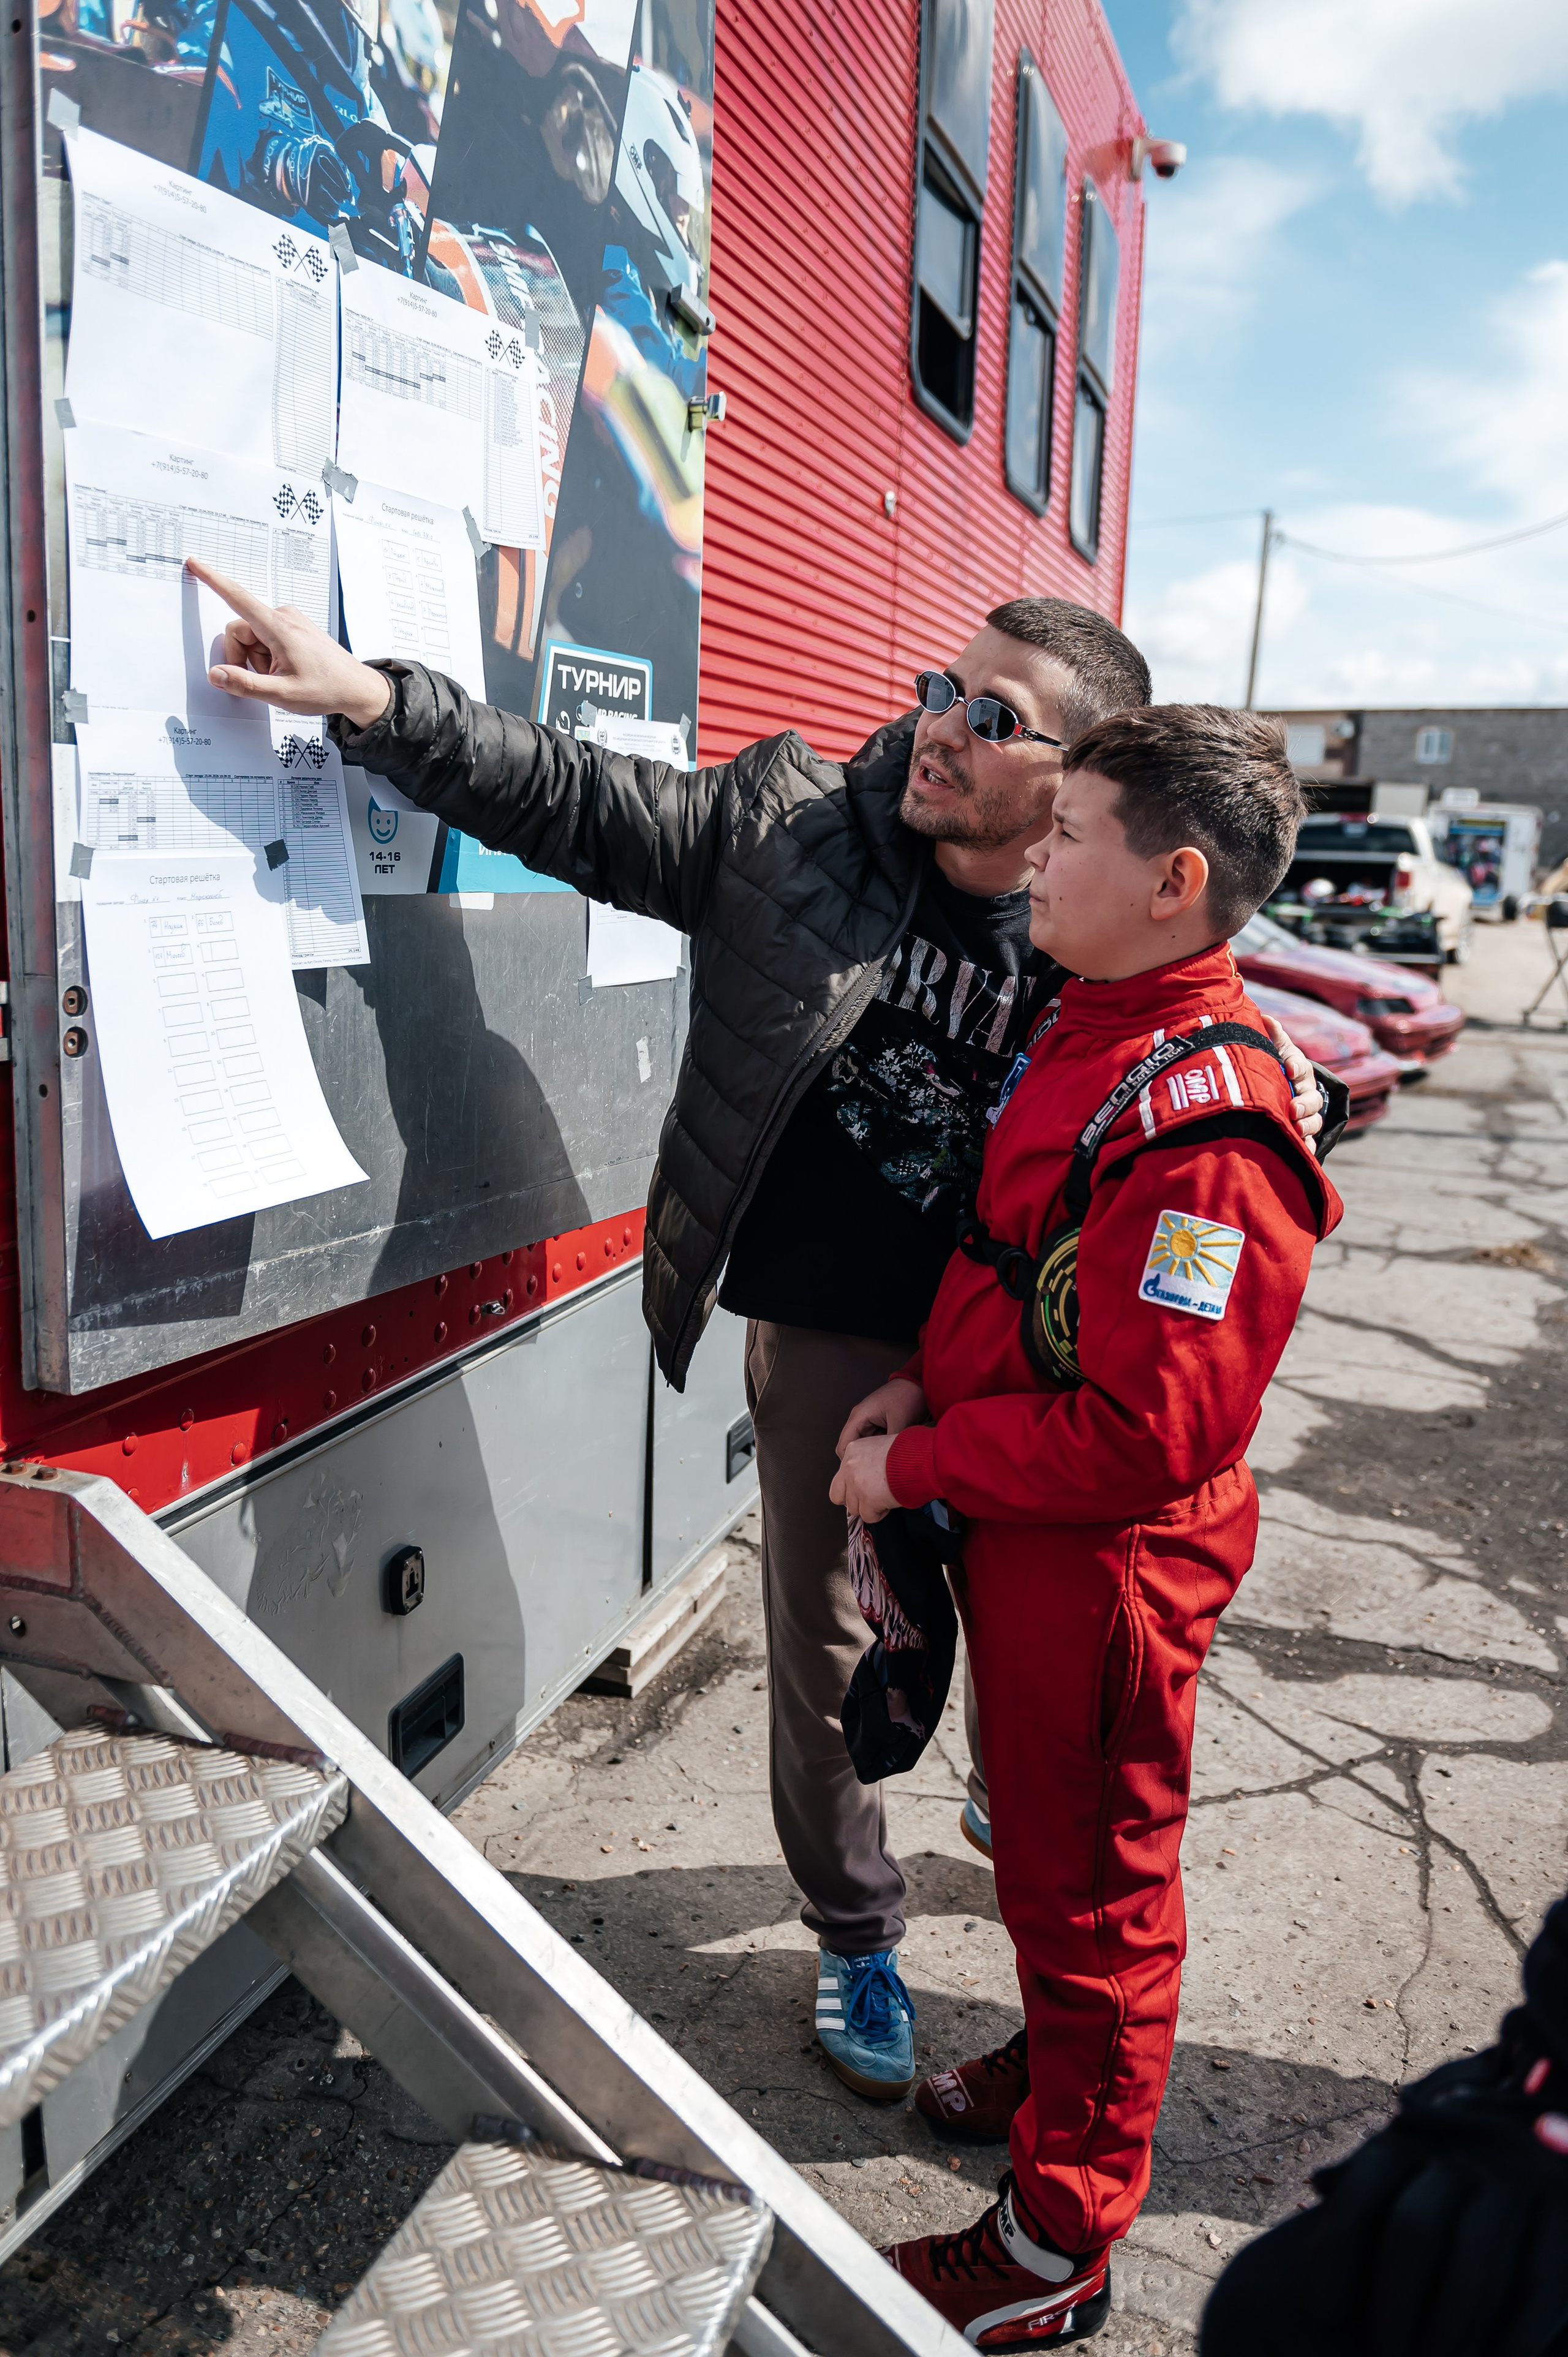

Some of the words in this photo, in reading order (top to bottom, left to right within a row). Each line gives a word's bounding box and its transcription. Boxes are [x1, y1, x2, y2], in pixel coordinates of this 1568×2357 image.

[168, 180, 193, 196] Картинг
[153, 184, 207, 214] +7(914)5-57-20-80
[410, 292, 428, 304] Картинг
[398, 297, 438, 318] +7(914)5-57-20-80
[169, 454, 194, 466] Картинг
[151, 462, 209, 480] +7(914)5-57-20-80
[382, 503, 410, 518] Стартовая
[411, 513, 434, 526] решётка
[557, 664, 642, 701] ТУРНИР
[158, 737, 211, 745] +7(914)5-57-20-80
[369, 851, 401, 862] 14-16
[374, 864, 396, 874] ЛЕТ
[149, 875, 189, 884] Стартовая
[190, 873, 221, 884] решётка
[1132, 1061, 1161, 1087] SAFETY
[1163, 1046, 1185, 1061] TECH
[1185, 1069, 1212, 1104] OMP
[853, 1954, 870, 1963] adidas
